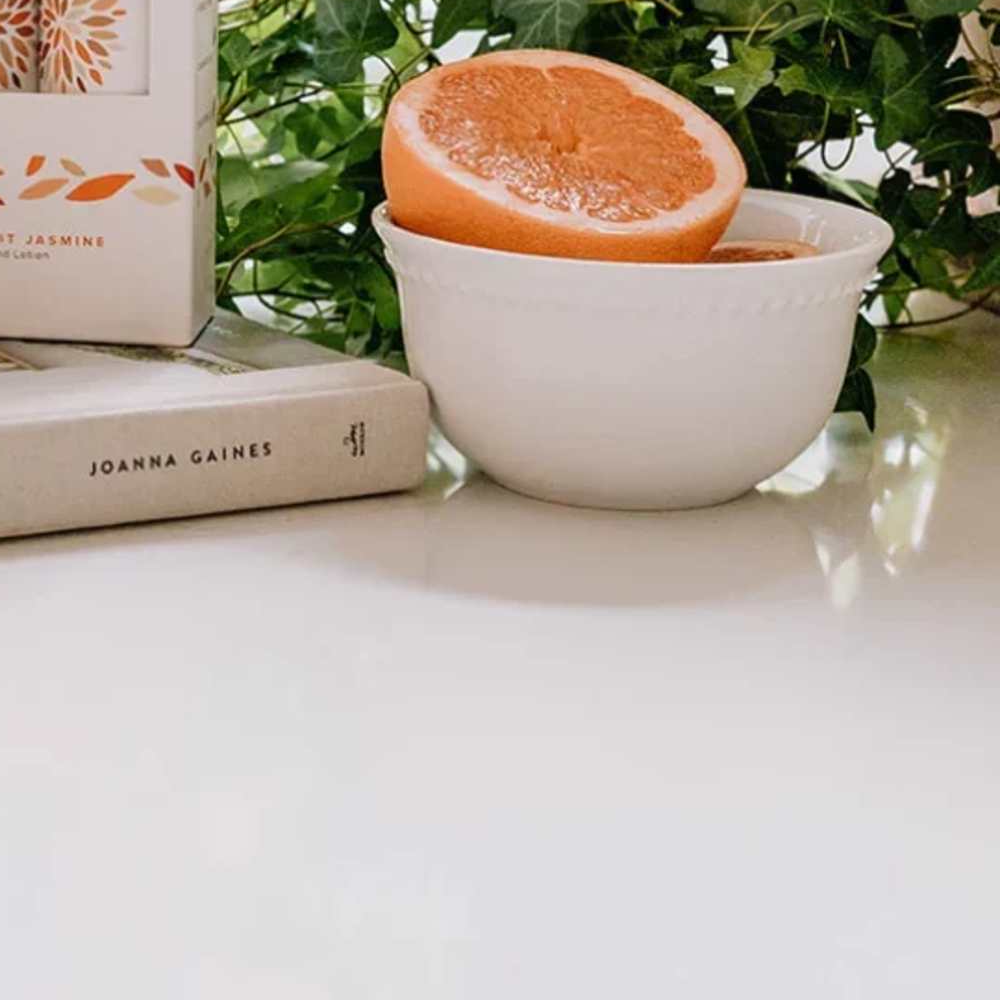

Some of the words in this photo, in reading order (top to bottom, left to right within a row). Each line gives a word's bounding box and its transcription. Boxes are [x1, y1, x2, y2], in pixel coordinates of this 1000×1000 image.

[26, 235, 104, 247] JASMINE
[90, 453, 176, 477] JOANNA
[191, 442, 272, 465] GAINES
